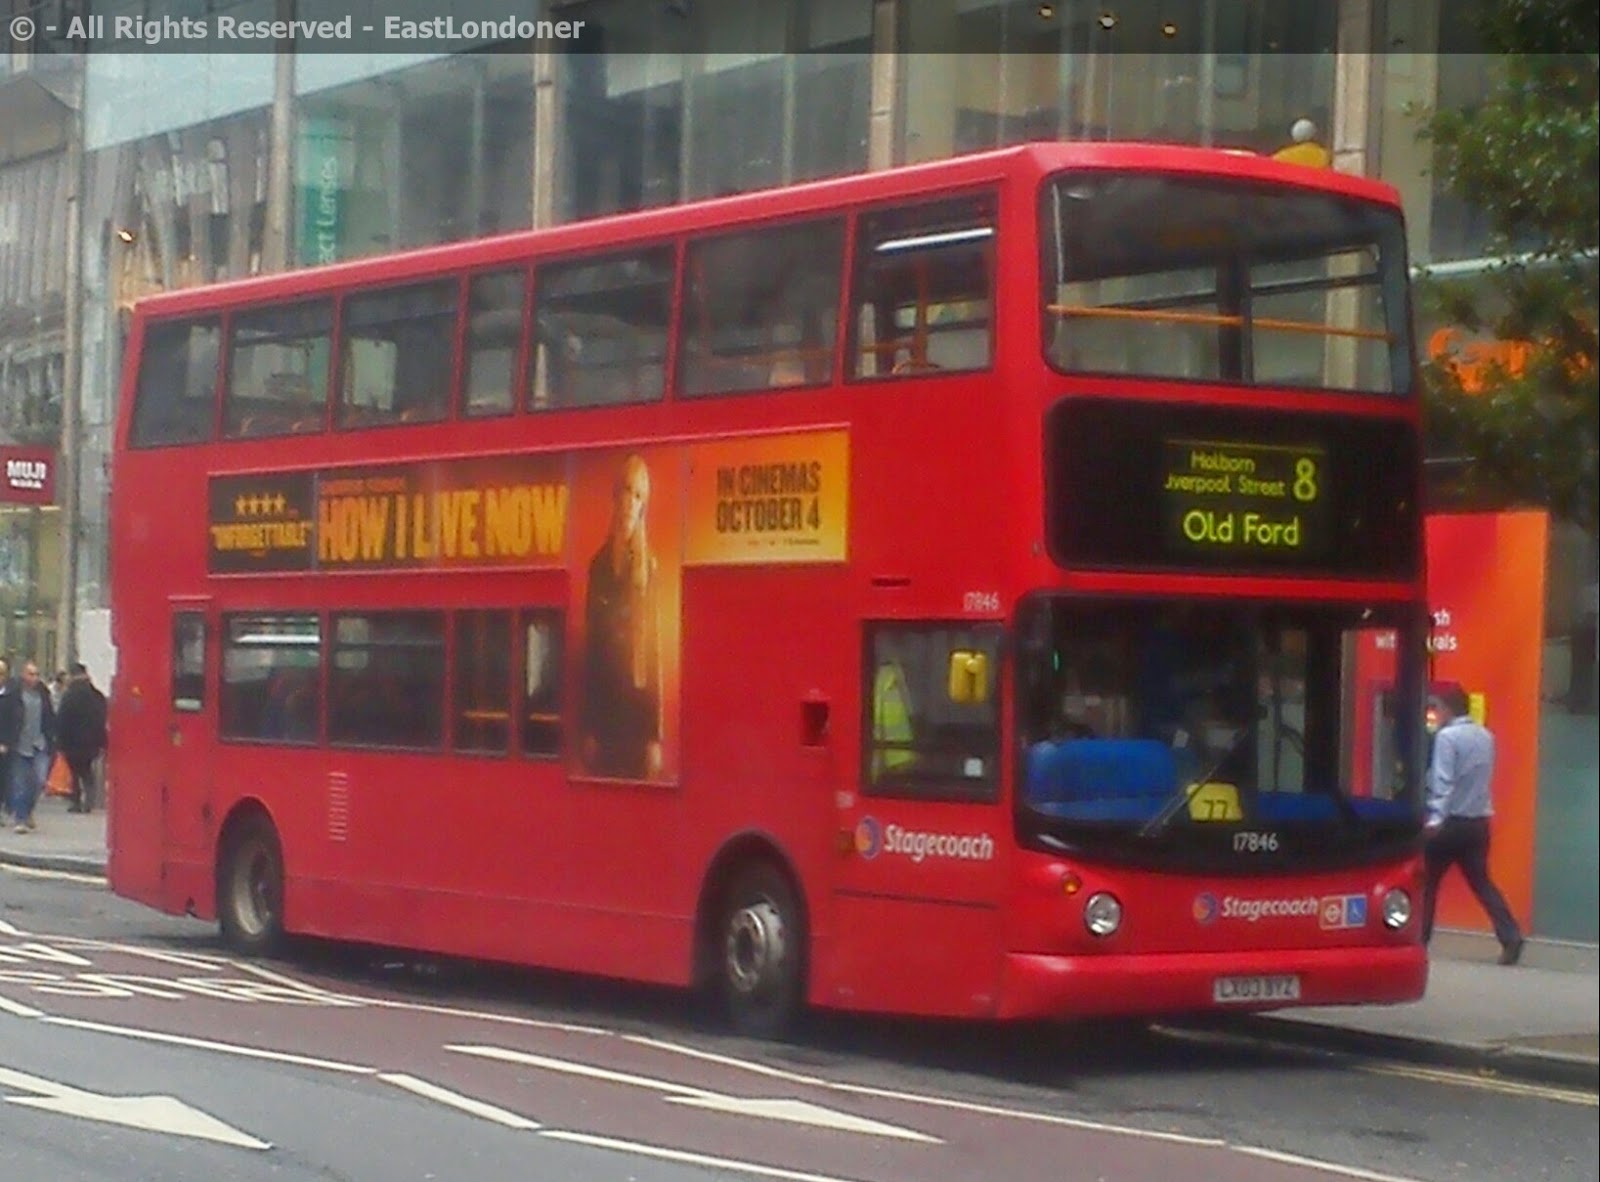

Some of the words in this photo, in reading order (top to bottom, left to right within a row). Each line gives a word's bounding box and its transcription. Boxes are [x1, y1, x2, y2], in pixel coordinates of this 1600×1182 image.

[7, 460, 46, 480] MUJI
[717, 466, 736, 496] IN
[740, 461, 821, 495] CINEMAS
[1238, 474, 1285, 497] Street
[1293, 457, 1316, 501] 8
[317, 493, 389, 561] HOW
[396, 493, 408, 558] I
[413, 489, 480, 558] LIVE
[485, 483, 567, 556] NOW
[717, 497, 802, 533] OCTOBER
[807, 496, 820, 530] 4
[1183, 510, 1233, 543] Old
[1243, 512, 1299, 546] Ford
[1202, 800, 1229, 819] 77
[884, 824, 994, 862] Stagecoach
[1233, 831, 1279, 852] 17846
[1221, 896, 1318, 922] Stagecoach
